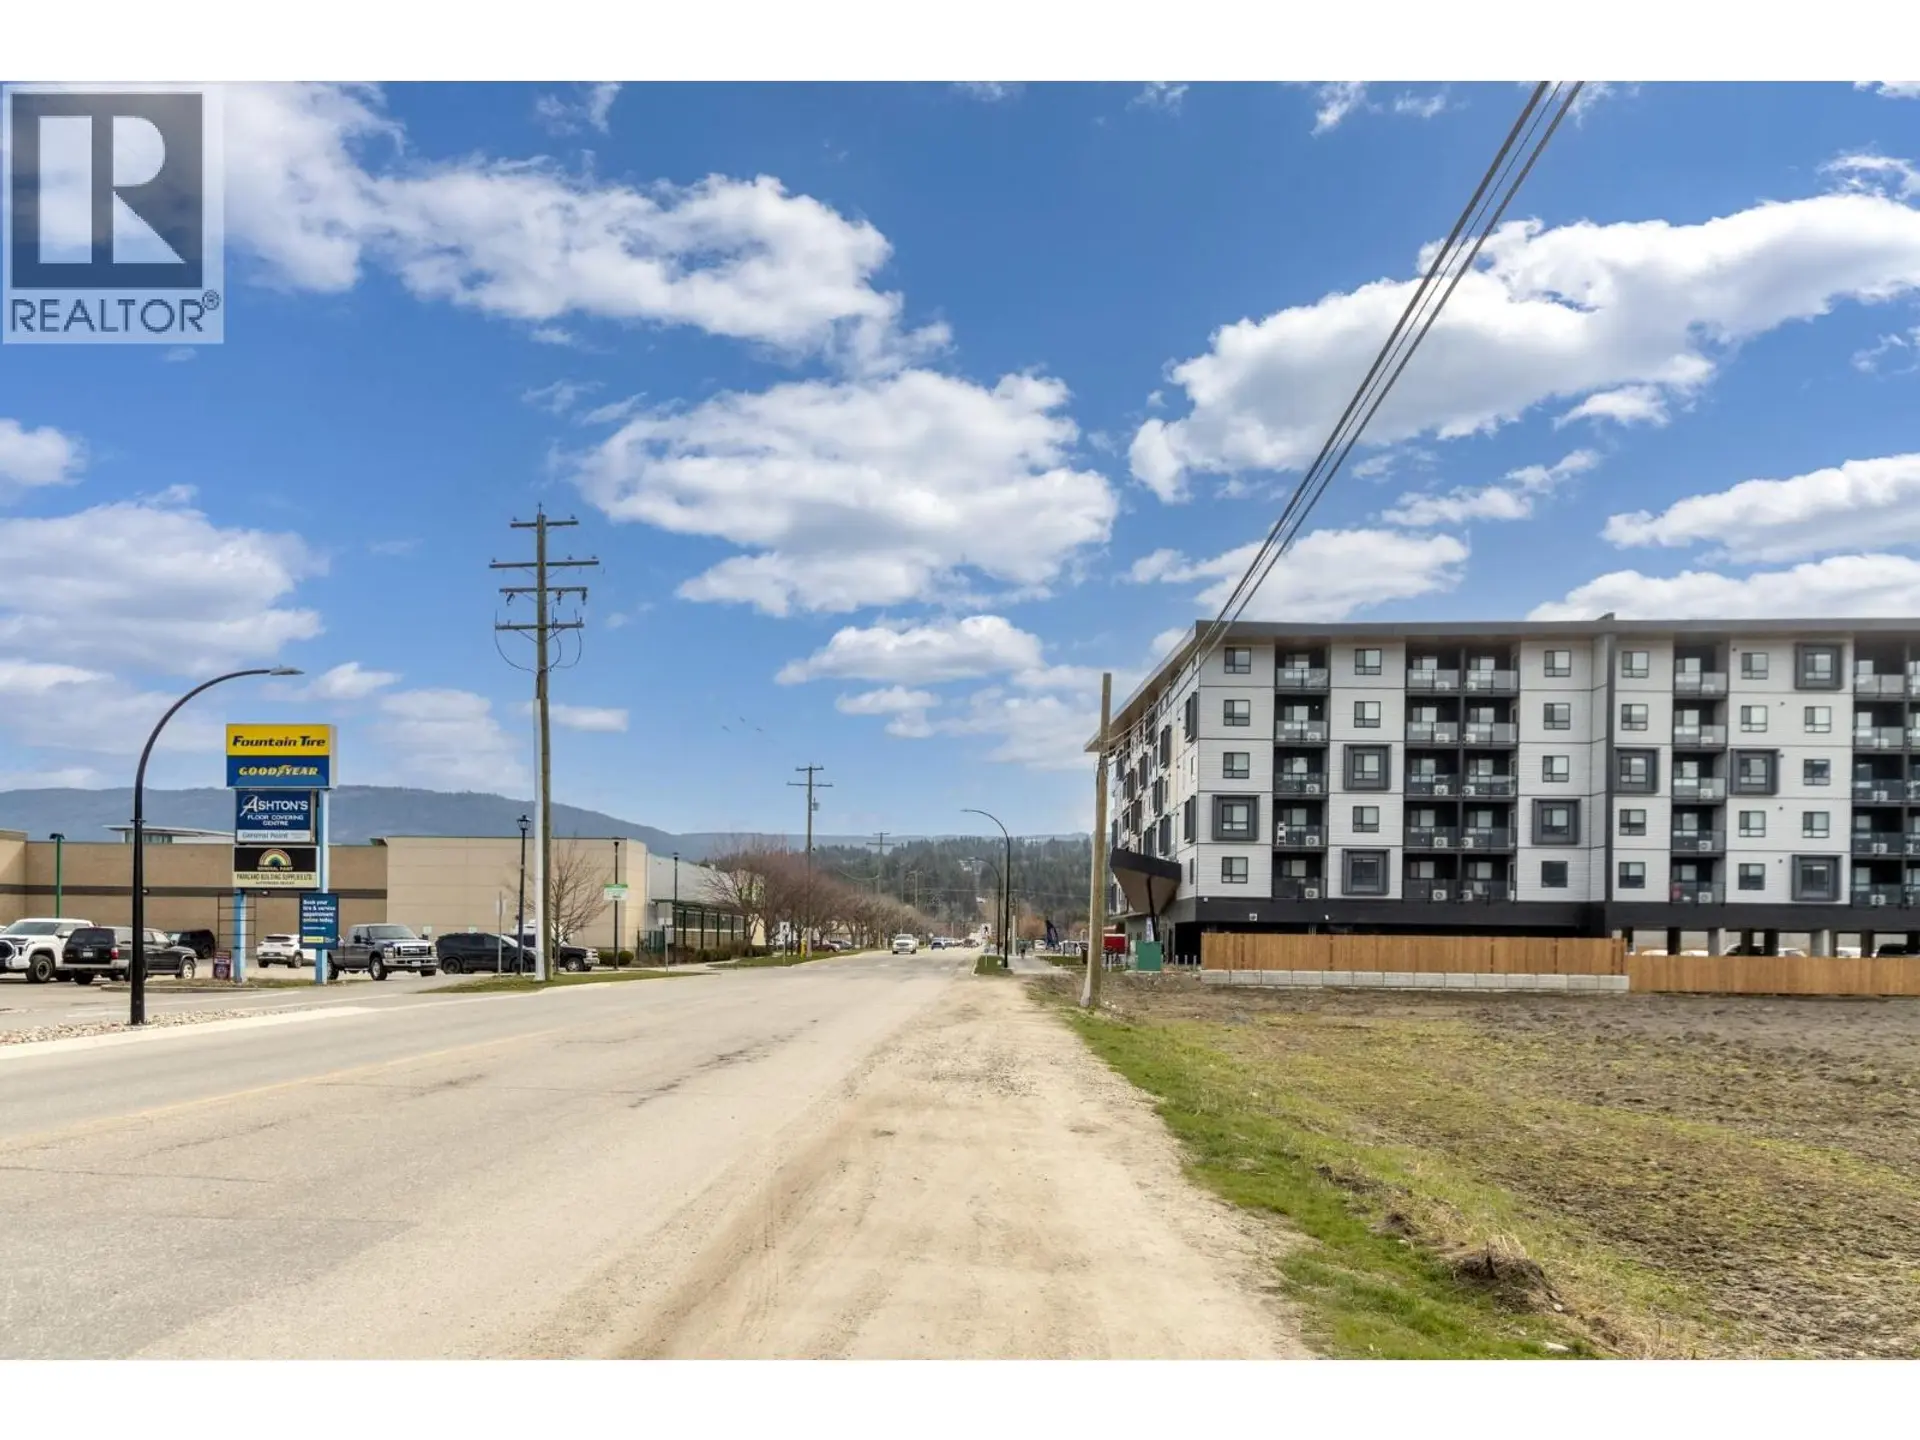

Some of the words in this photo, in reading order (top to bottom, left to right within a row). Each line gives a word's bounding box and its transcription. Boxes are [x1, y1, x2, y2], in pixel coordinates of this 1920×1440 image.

[232, 735, 298, 747] Fountain
[299, 735, 326, 747] Tire
[238, 764, 319, 777] GOODYEAR
[240, 794, 309, 817] ASHTON'S
